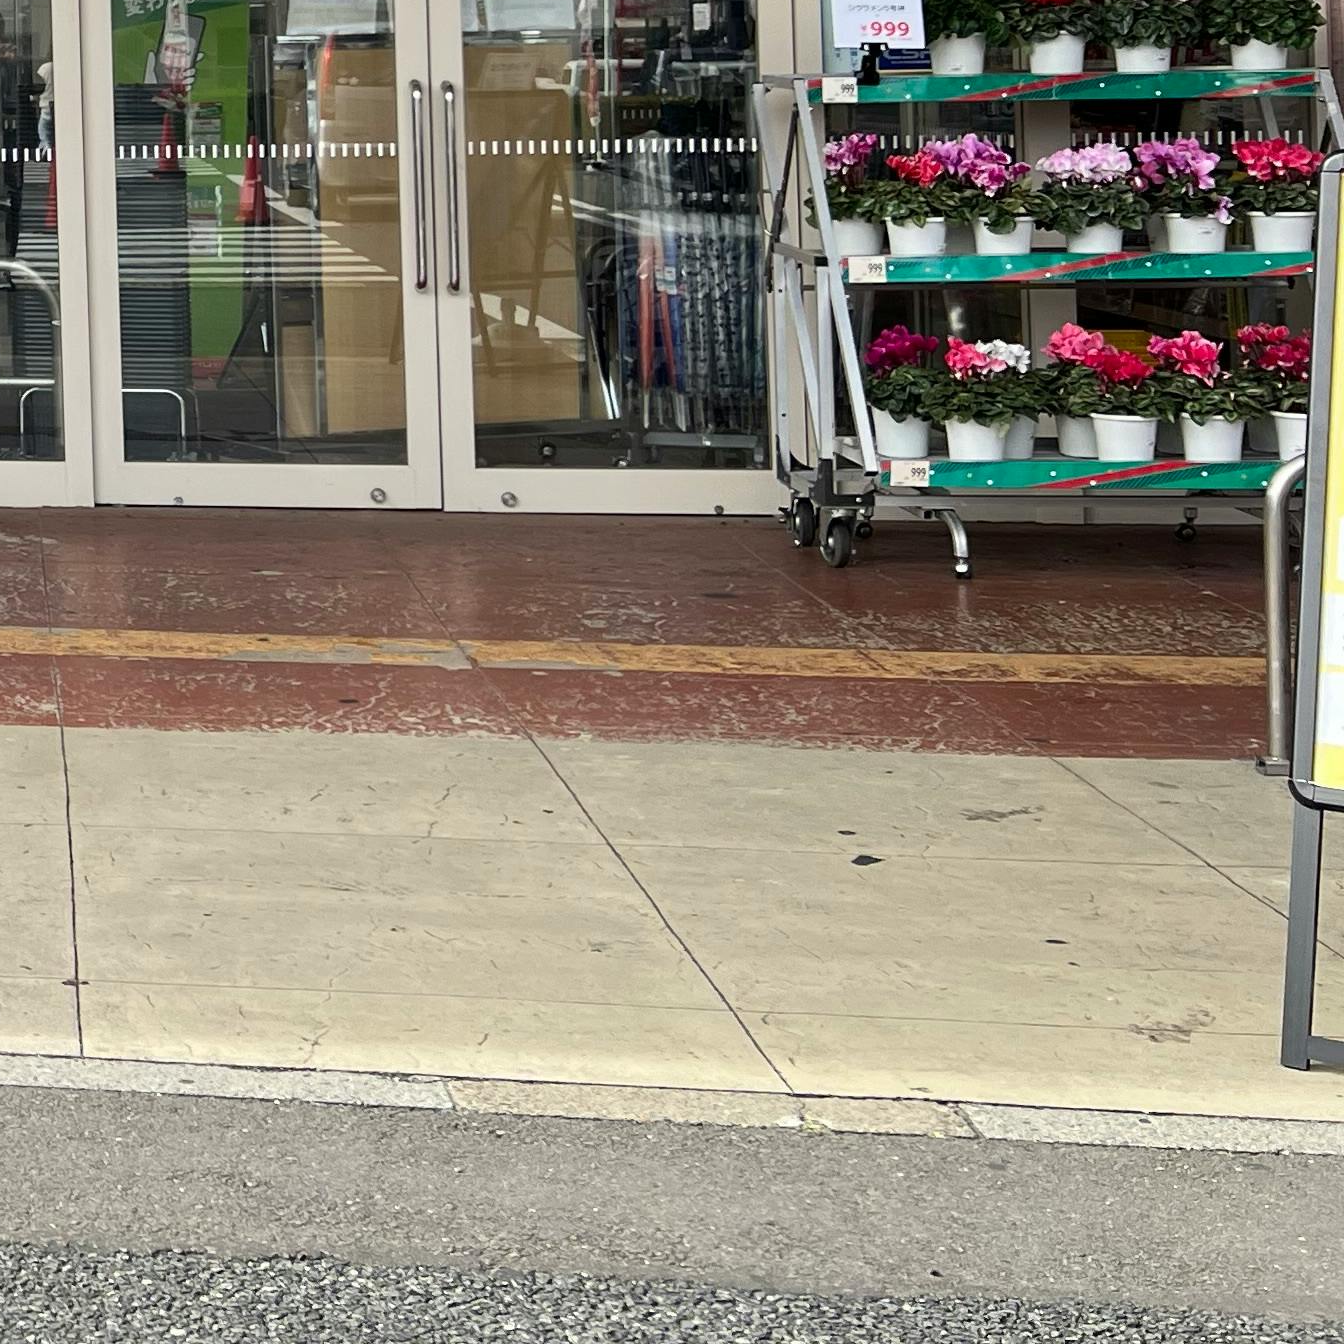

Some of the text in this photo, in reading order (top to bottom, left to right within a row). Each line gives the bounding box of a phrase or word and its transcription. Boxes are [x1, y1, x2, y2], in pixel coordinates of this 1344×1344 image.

[840, 83, 855, 94] 999
[868, 262, 883, 273] 999
[911, 467, 927, 478] 999
